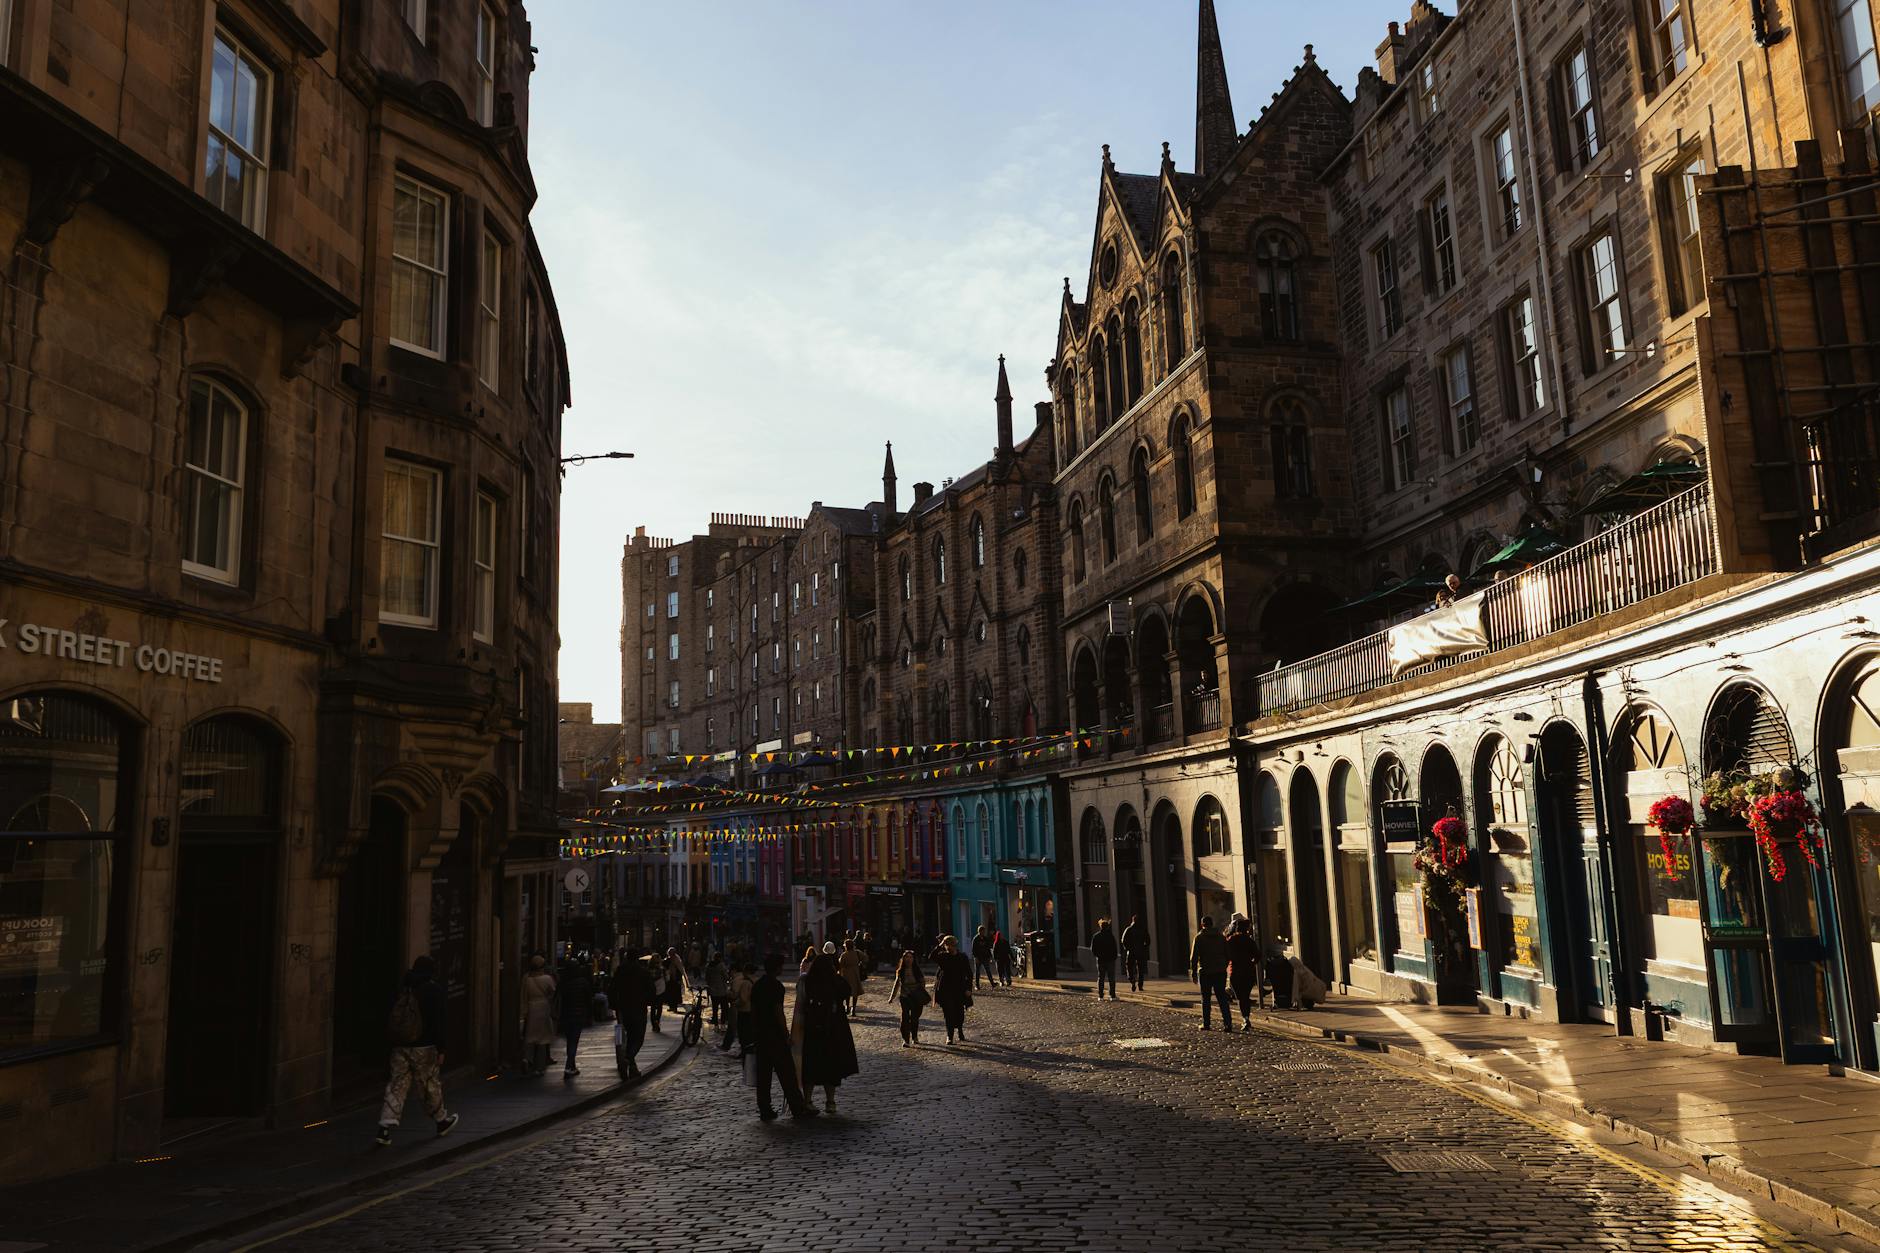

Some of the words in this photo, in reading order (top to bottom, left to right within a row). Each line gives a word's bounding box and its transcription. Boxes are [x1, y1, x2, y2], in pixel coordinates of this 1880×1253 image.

[19, 624, 130, 667] STREET
[135, 645, 223, 683] COFFEE
[1385, 821, 1416, 830] HOWIES
[576, 875, 585, 887] K
